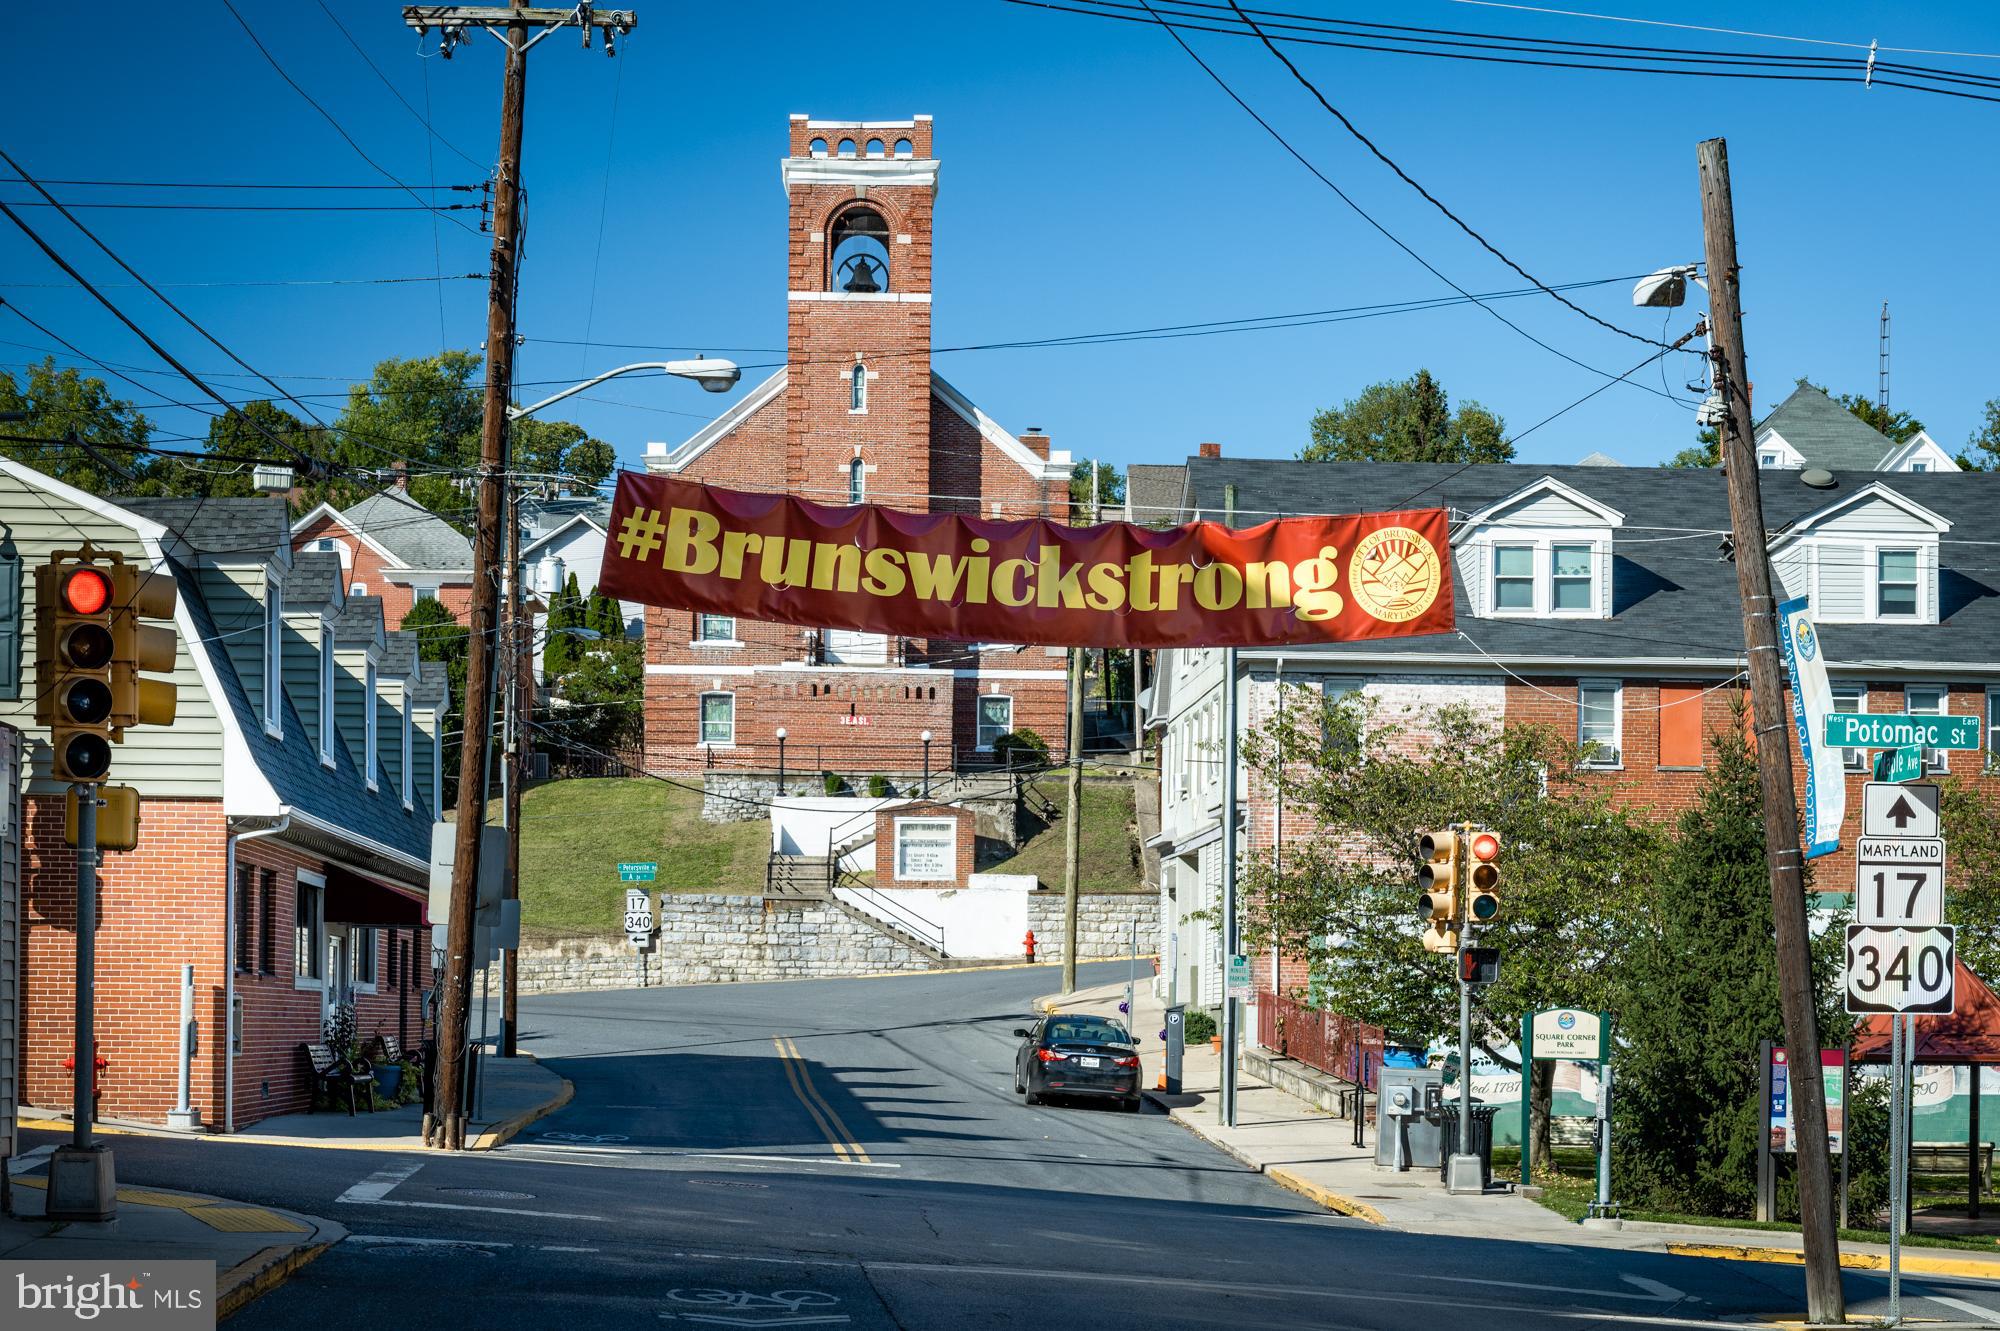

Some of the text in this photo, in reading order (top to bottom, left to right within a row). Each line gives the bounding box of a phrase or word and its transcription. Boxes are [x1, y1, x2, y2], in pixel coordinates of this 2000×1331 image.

[1354, 529, 1434, 566] CITY OF BRUNSWICK
[616, 506, 1344, 622] #Brunswickstrong
[1373, 602, 1424, 620] MARYLAND
[1828, 715, 1844, 723] West
[1962, 717, 1978, 726] East
[1781, 614, 1815, 847] WELCOME TO BRUNSWICK
[1845, 718, 1966, 745] Potomac St
[1881, 750, 1919, 782] Maple Ave
[1862, 844, 1939, 858] MARYLAND
[622, 864, 650, 872] Petersville
[631, 897, 645, 909] 17
[1872, 871, 1927, 919] 17
[627, 916, 650, 928] 340
[1856, 944, 1945, 992] 340
[1535, 1033, 1564, 1041] SQUARE
[1493, 1080, 1522, 1093] 1787
